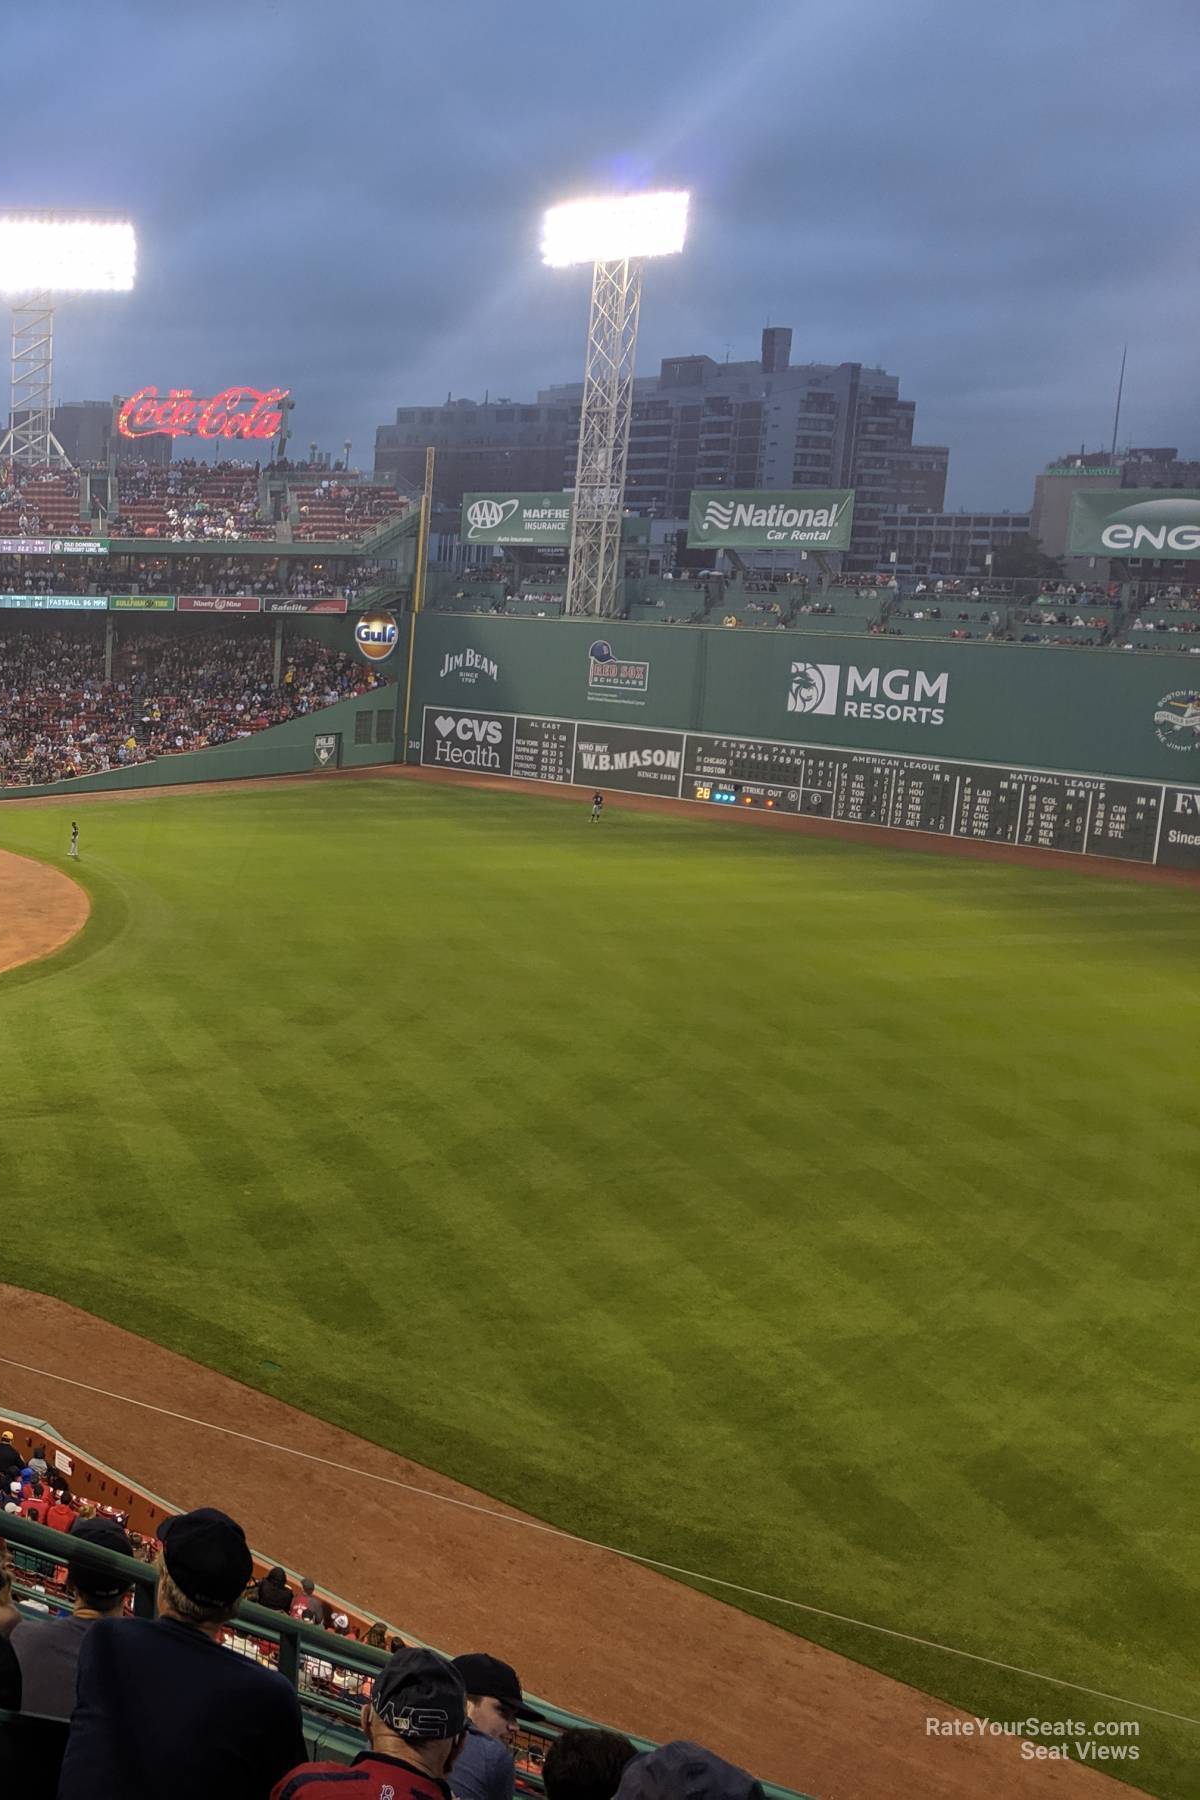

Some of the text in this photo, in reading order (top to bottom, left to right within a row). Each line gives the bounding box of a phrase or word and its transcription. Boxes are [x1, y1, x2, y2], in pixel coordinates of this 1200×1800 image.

[523, 508, 570, 518] MAPFRE
[524, 522, 566, 530] INSURANCE
[766, 530, 831, 540] Car Rental
[116, 599, 146, 607] SULLIVAN
[356, 625, 396, 642] Gulf
[440, 648, 498, 681] JIM BEAM
[593, 664, 645, 680] RED SOX
[594, 678, 644, 686] SCHOLARS
[846, 666, 949, 704] MGM
[844, 701, 945, 725] RESORTS
[542, 722, 560, 730] EAST
[456, 718, 503, 744] CVS
[578, 743, 608, 753] WHO BUT
[714, 740, 806, 756] FENWAY PARK
[434, 740, 500, 768] Health
[703, 756, 728, 766] CHICAGO
[794, 758, 802, 766] 10
[852, 755, 940, 772] AMERICAN LEAGUE
[515, 762, 536, 770] TORONTO
[874, 766, 881, 774] IN
[514, 770, 538, 778] BALTIMORE
[638, 770, 659, 780] SINCE
[702, 766, 726, 776] BOSTON
[932, 773, 941, 782] IN
[1010, 773, 1106, 790] NATIONAL LEAGUE
[851, 780, 865, 790] BAL
[911, 780, 923, 788] PIT
[696, 787, 712, 800] 28
[702, 781, 714, 789] BAT
[718, 782, 736, 792] BALL
[742, 786, 764, 796] STRIKE
[768, 789, 783, 798] OUT
[851, 789, 865, 798] TOR
[908, 788, 924, 796] HOU
[977, 788, 992, 797] LAD
[912, 796, 920, 804] TB
[977, 797, 990, 805] ARI
[1042, 797, 1058, 806] COL
[1136, 796, 1146, 806] IN
[850, 804, 861, 812] KC
[1044, 804, 1054, 812] SF
[1112, 804, 1127, 814] CIN
[848, 810, 862, 820] CLE
[907, 811, 920, 820] TEX
[973, 812, 990, 821] CHC
[1040, 813, 1057, 822] WSH
[1110, 813, 1126, 822] LAA
[906, 820, 920, 828] DET
[972, 820, 989, 829] NYM
[1040, 821, 1054, 830] MIA
[1109, 822, 1125, 830] OAK
[973, 828, 987, 836] PHI
[1039, 828, 1054, 838] SEA
[1108, 830, 1124, 838] STL
[1038, 837, 1052, 846] MIL
